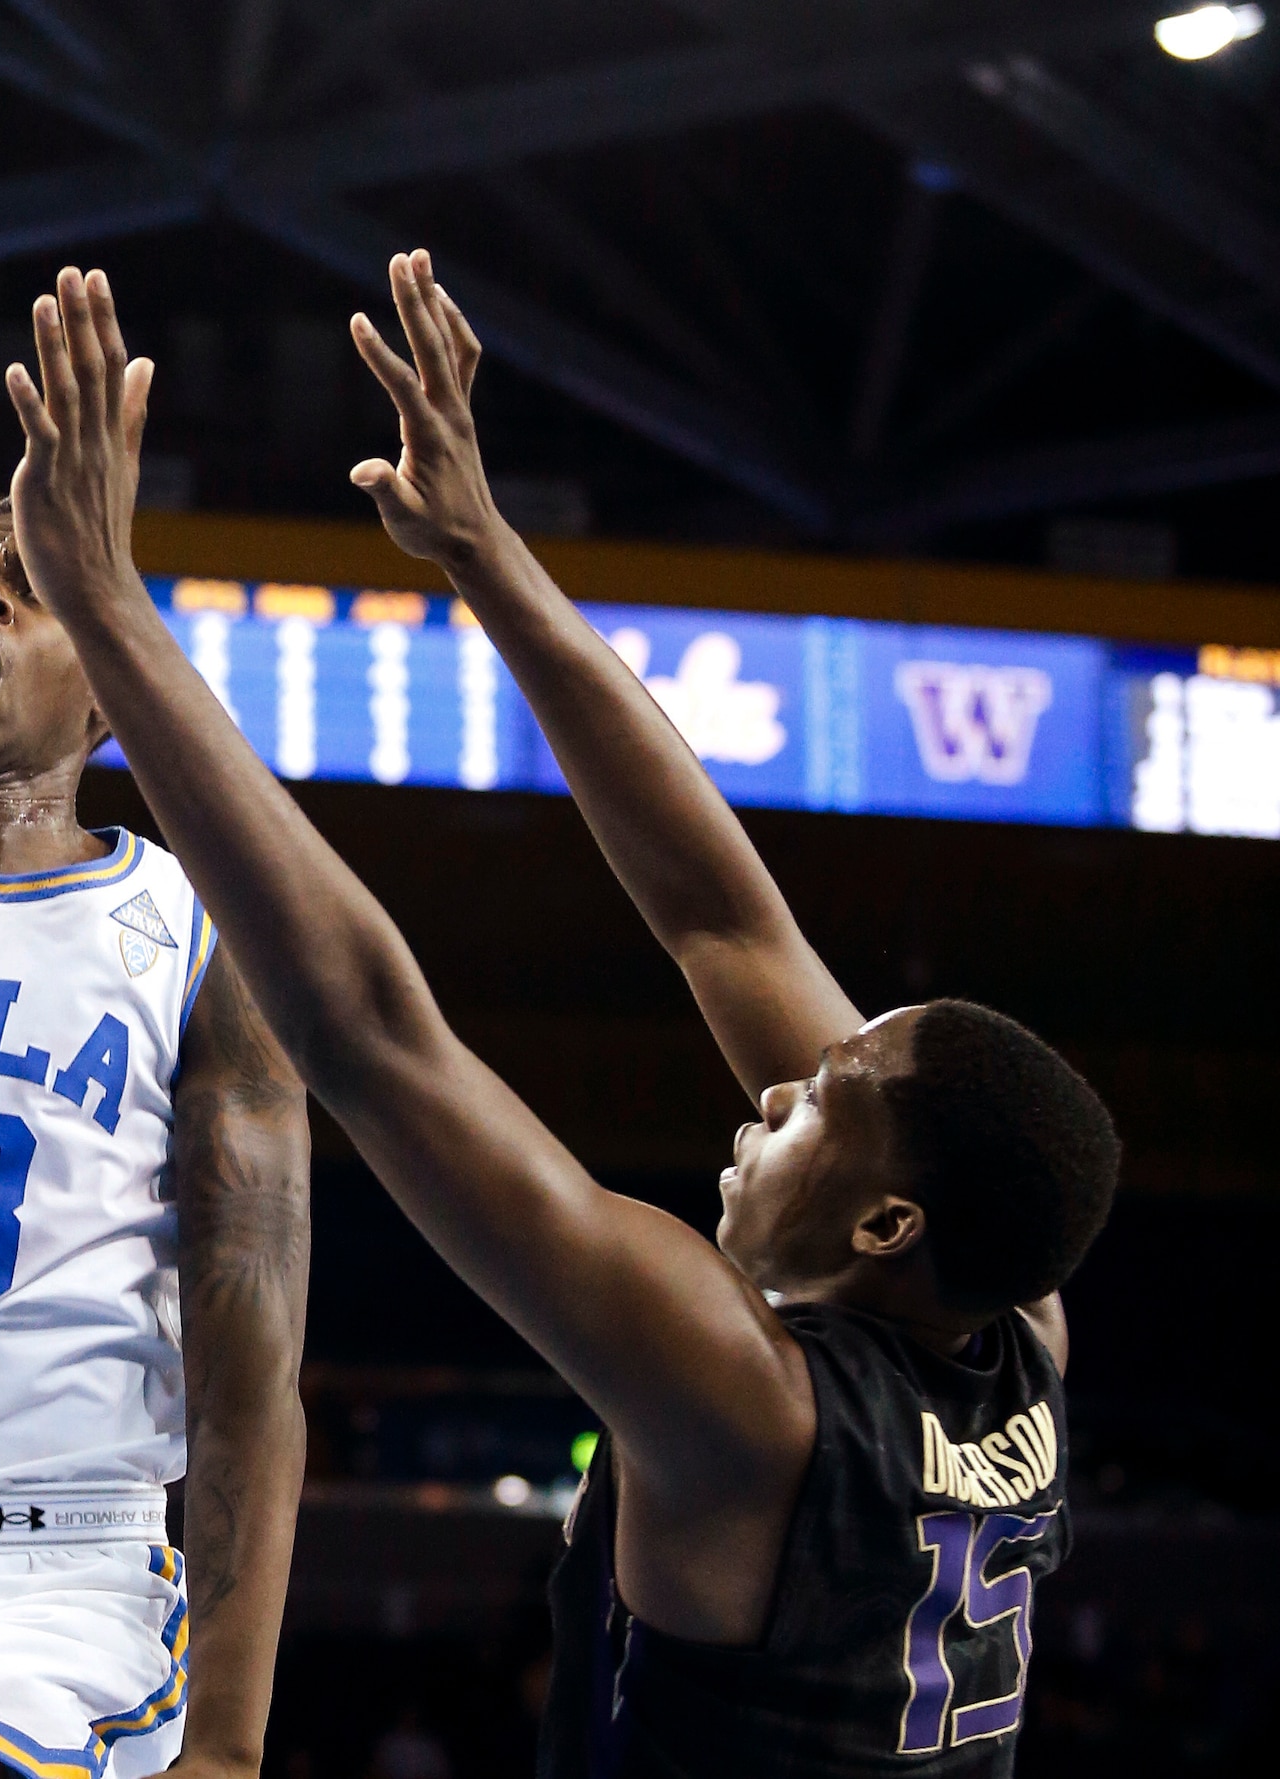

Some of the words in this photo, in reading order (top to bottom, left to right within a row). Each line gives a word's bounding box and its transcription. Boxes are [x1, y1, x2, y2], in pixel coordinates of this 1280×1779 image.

[893, 659, 1053, 786] W
[55, 1510, 136, 1525] ARMOUR
[896, 1499, 1062, 1755] 15
